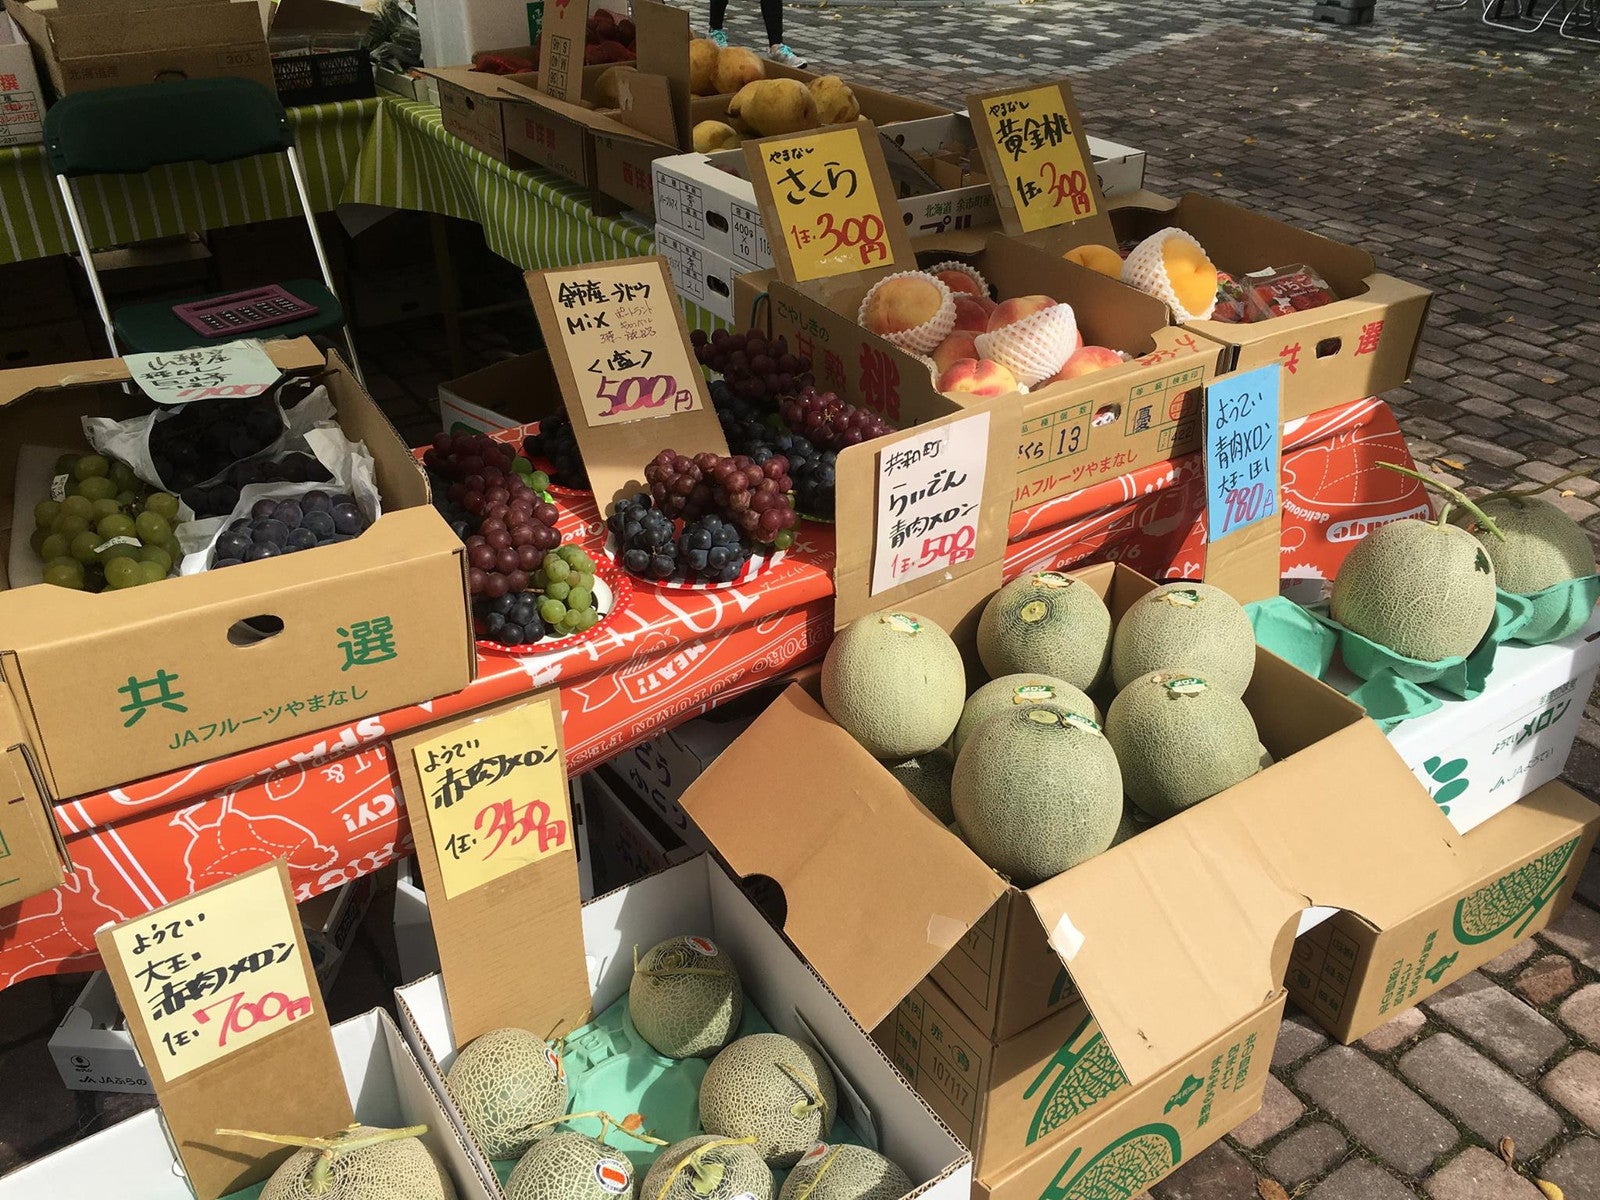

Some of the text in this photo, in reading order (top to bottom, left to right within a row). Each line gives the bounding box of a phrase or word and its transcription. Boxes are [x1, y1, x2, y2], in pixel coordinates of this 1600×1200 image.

[989, 101, 1030, 118] やまなし
[769, 147, 815, 165] やまなし
[996, 112, 1072, 162] 黄金桃
[777, 161, 858, 205] さくら
[739, 244, 751, 256] 10
[816, 212, 887, 265] 300円
[596, 374, 693, 417] 500円
[1215, 392, 1263, 430] ようてい
[884, 439, 943, 477] 共和町
[1057, 425, 1081, 455] 13
[889, 469, 968, 518] らいでん
[1283, 497, 1331, 524] delicious!
[889, 502, 979, 549] 青肉メロン
[918, 525, 977, 568] 500円
[637, 638, 708, 696] MEAT!
[168, 685, 369, 750] JAフルーツやまなし
[423, 738, 480, 773] ようてい
[431, 745, 559, 810] 赤肉メロン
[474, 798, 567, 862] 350円
[132, 913, 206, 955] ようてい
[147, 942, 295, 1021] 赤肉メロン
[192, 991, 312, 1048] 700円
